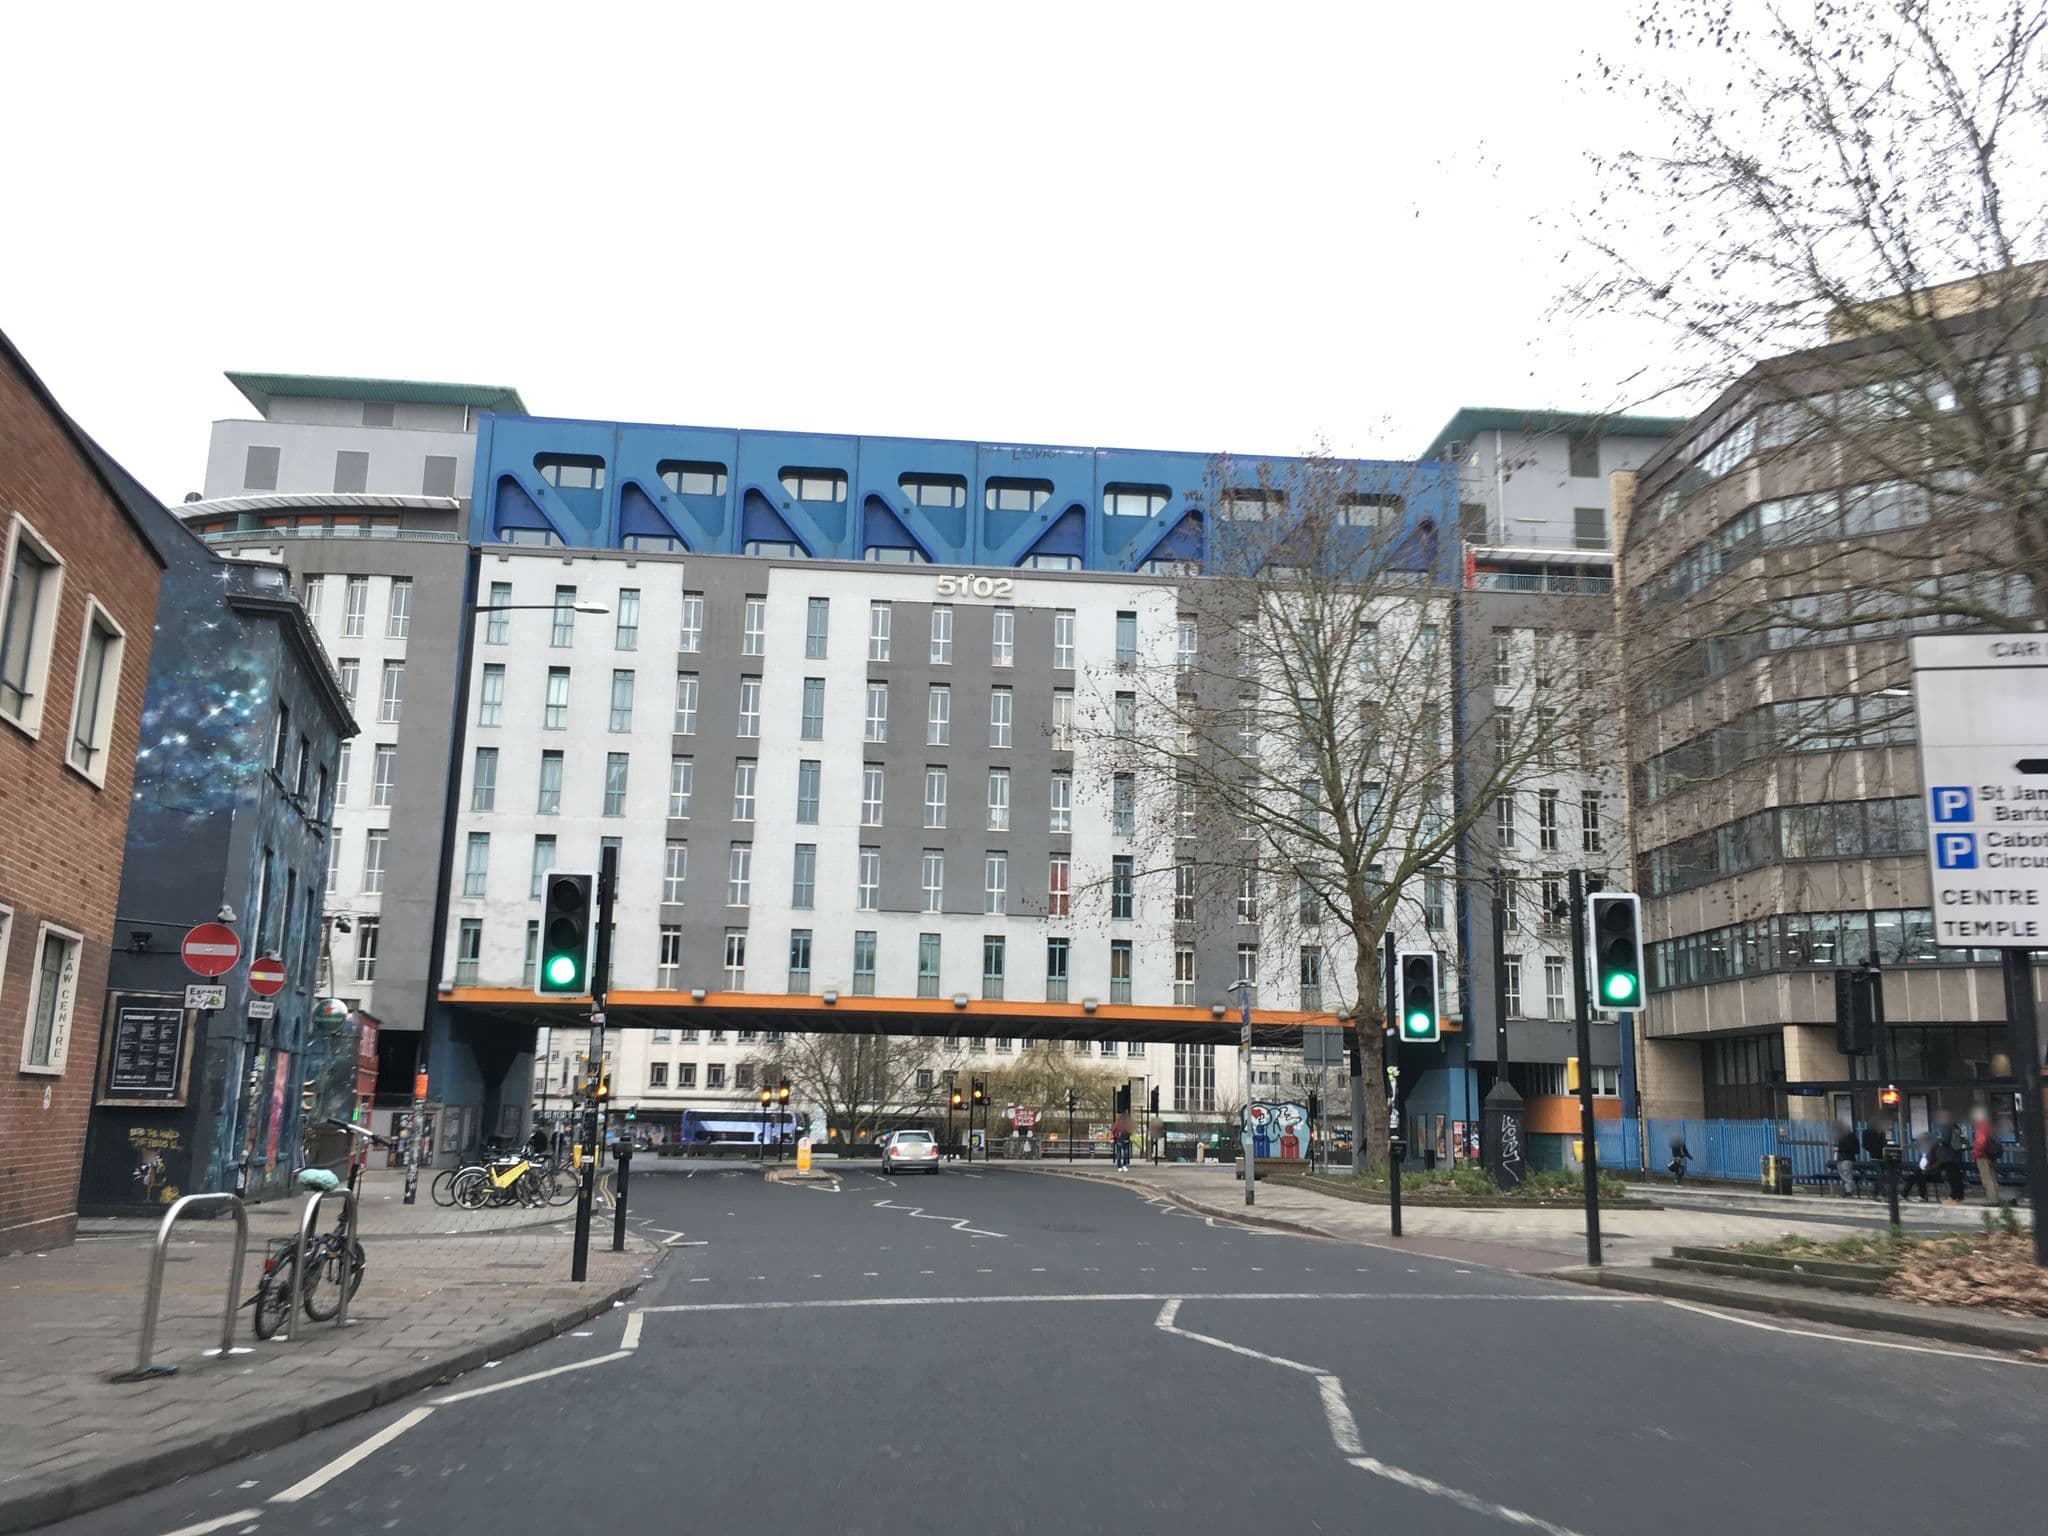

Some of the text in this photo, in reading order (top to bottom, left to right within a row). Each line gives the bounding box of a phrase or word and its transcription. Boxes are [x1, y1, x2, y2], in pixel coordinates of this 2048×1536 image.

[1979, 785, 2005, 801] St
[1942, 889, 2039, 906] CENTRE
[1943, 920, 2039, 937] TEMPLE
[53, 951, 74, 1058] LAW CENTRE
